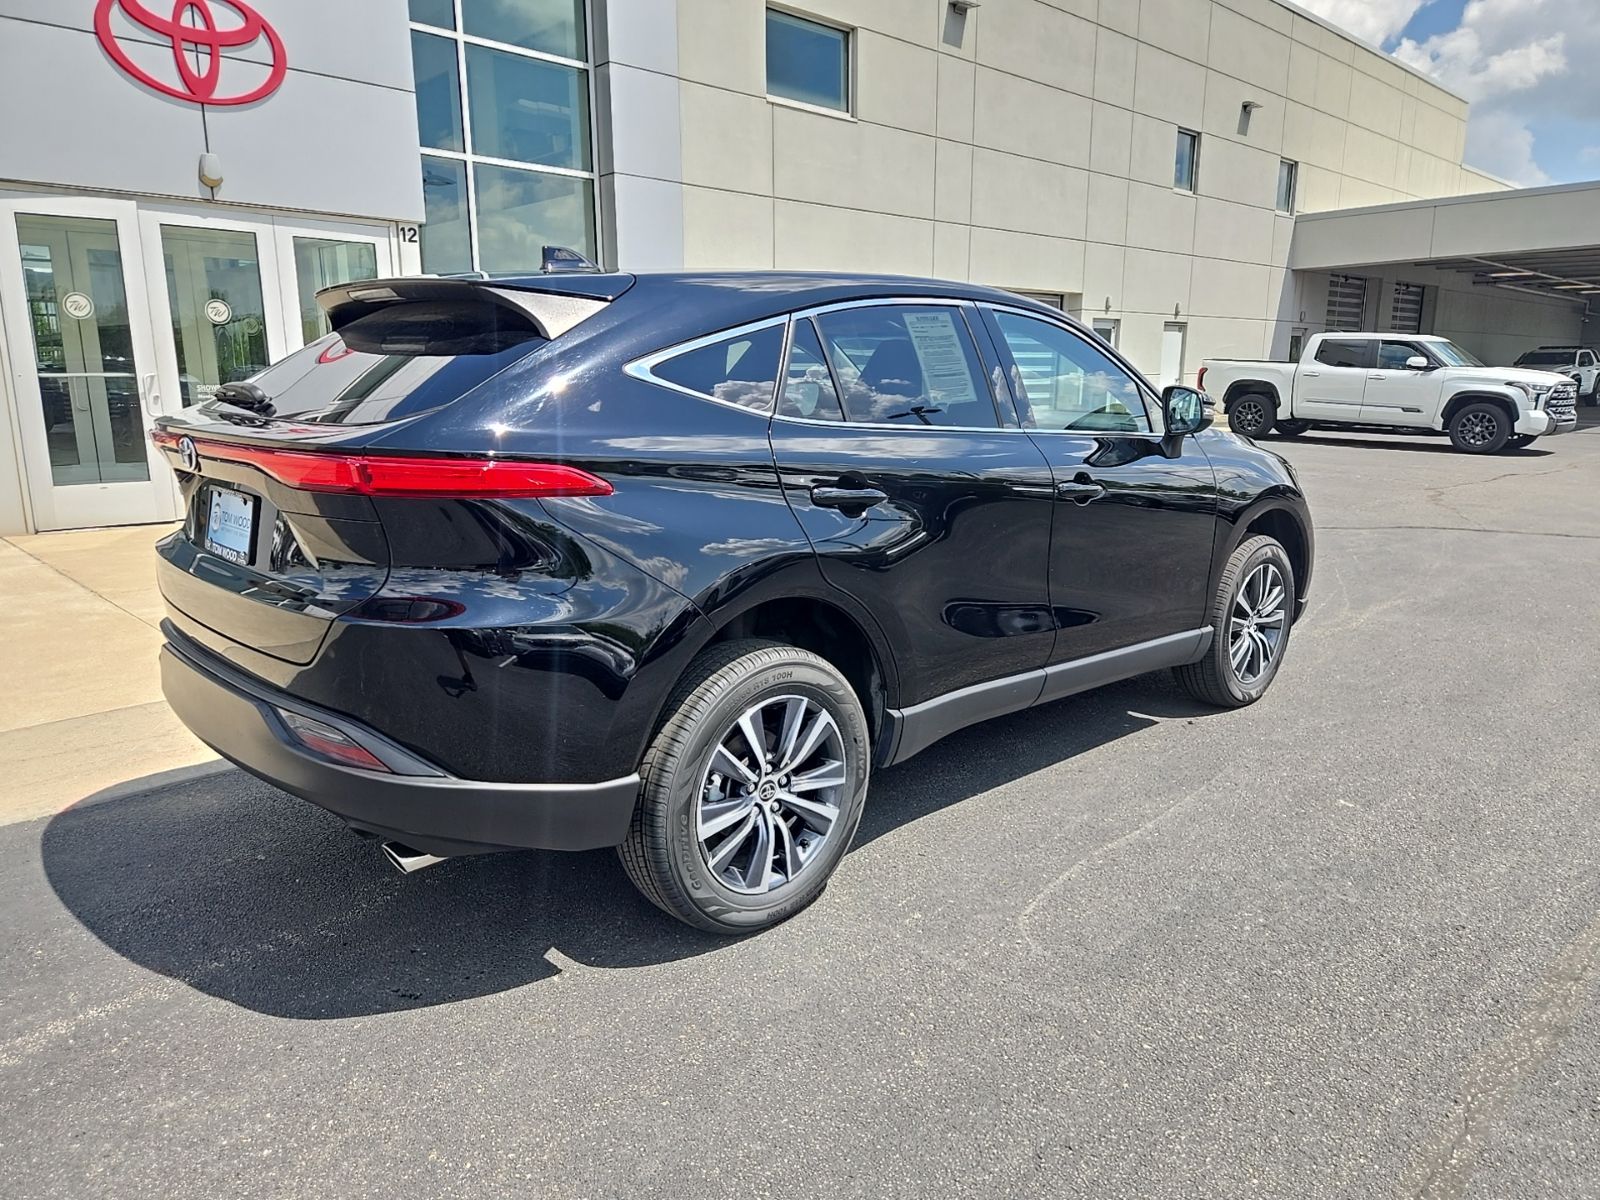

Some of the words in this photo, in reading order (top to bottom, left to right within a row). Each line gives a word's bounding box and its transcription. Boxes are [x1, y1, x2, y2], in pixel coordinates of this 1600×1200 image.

[400, 226, 418, 243] 12
[221, 511, 233, 524] TOM
[212, 542, 223, 555] TOM
[223, 546, 237, 562] WOOD
[772, 671, 793, 682] 100H
[680, 814, 701, 890] GeoDrive
